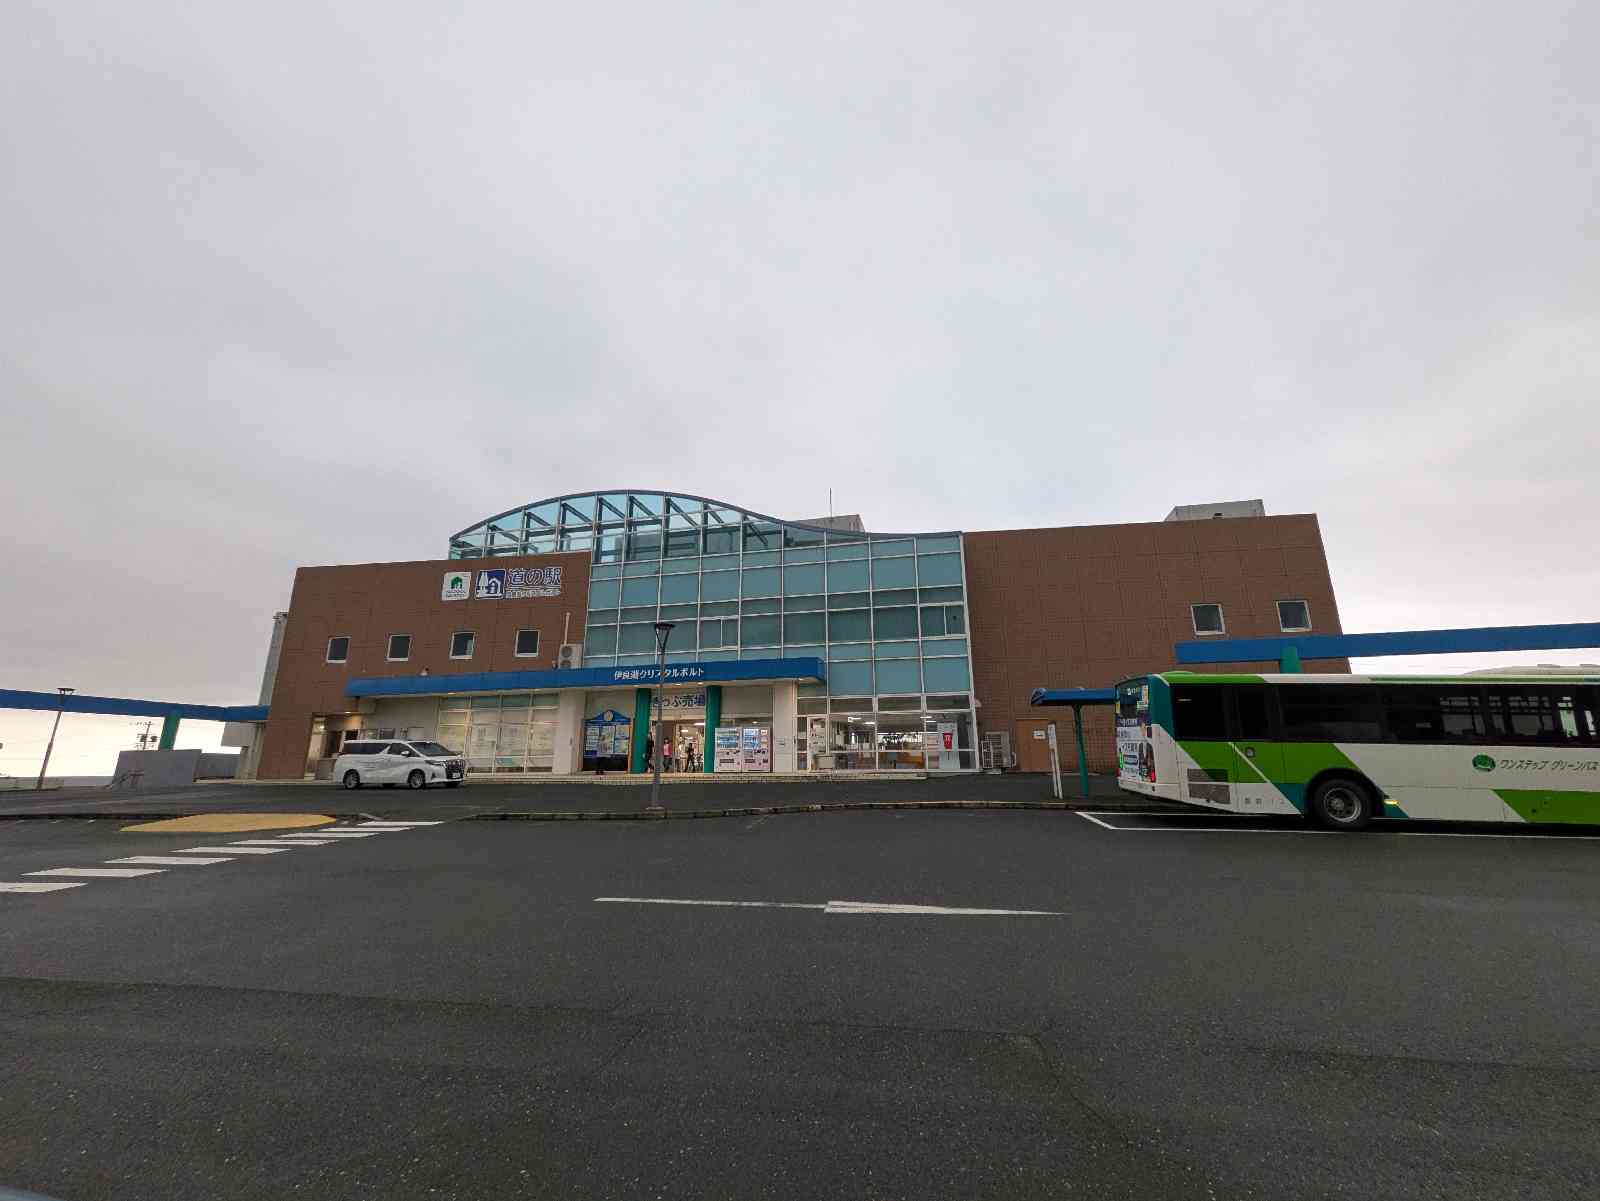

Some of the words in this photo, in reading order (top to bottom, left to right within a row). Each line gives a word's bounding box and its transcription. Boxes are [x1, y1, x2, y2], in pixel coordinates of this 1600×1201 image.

[506, 567, 561, 587] 道の駅
[1501, 759, 1549, 770] ワンステップ
